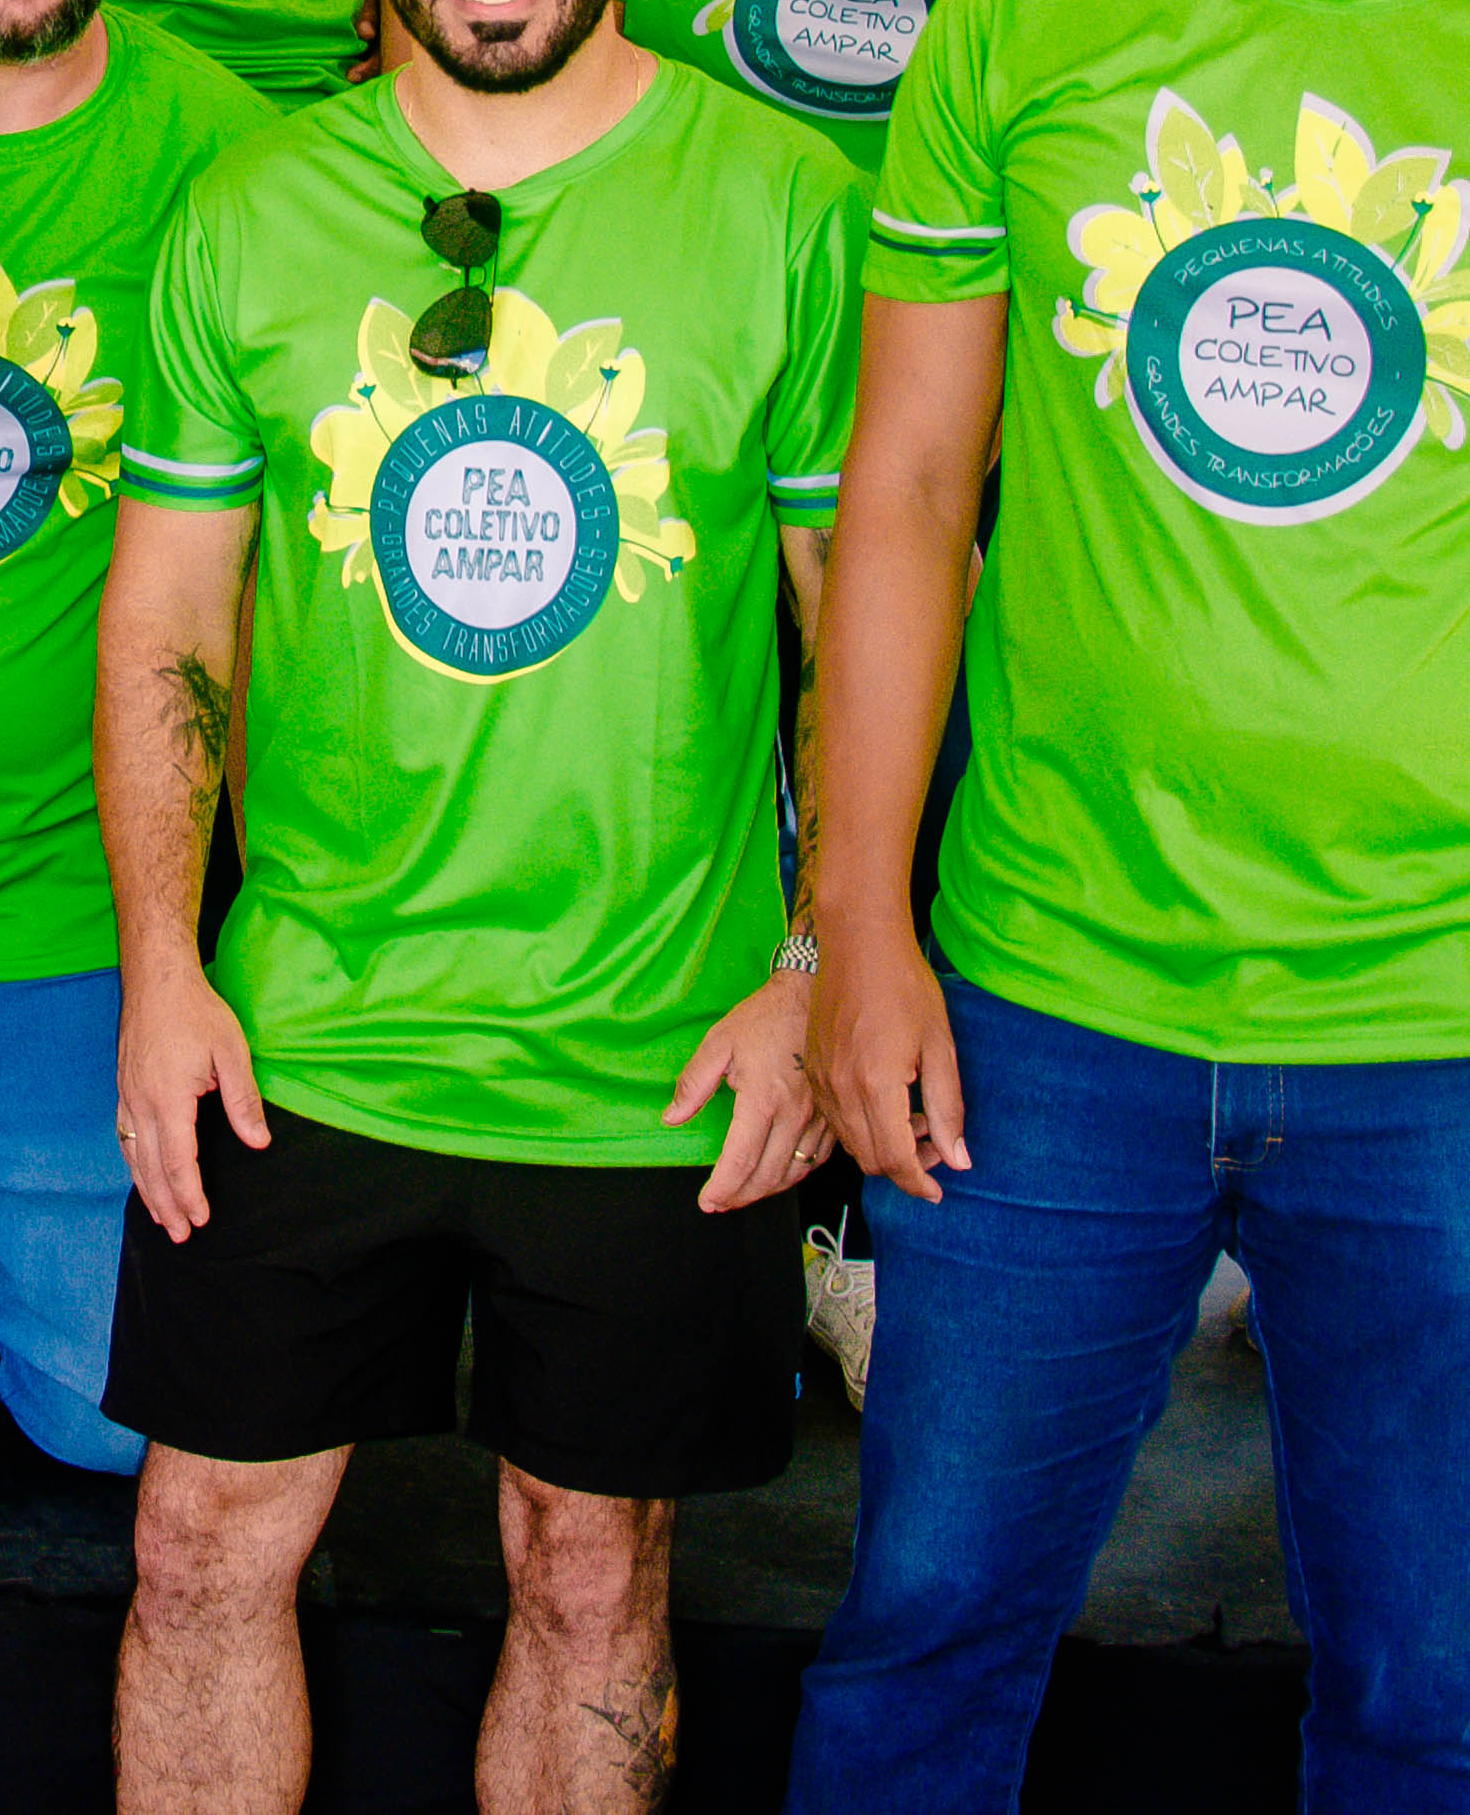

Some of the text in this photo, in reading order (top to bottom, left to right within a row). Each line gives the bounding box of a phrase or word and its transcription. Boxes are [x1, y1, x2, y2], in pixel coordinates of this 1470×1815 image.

[792, 28, 899, 63] AMPAR
[1174, 238, 1397, 332] PEQUENAS ATITUDES
[1226, 297, 1333, 342] PEA
[1195, 339, 1356, 378] COLETIVO
[1204, 376, 1335, 415] AMPAR
[1147, 355, 1395, 488] GRANDES TRANSFORMAÇÕES
[378, 402, 611, 522] PEQUENAS ATITUDES
[462, 467, 531, 507] PEA
[424, 508, 560, 543] COLETIVO
[381, 534, 438, 635] GRANDES
[430, 547, 544, 582] AMPAR
